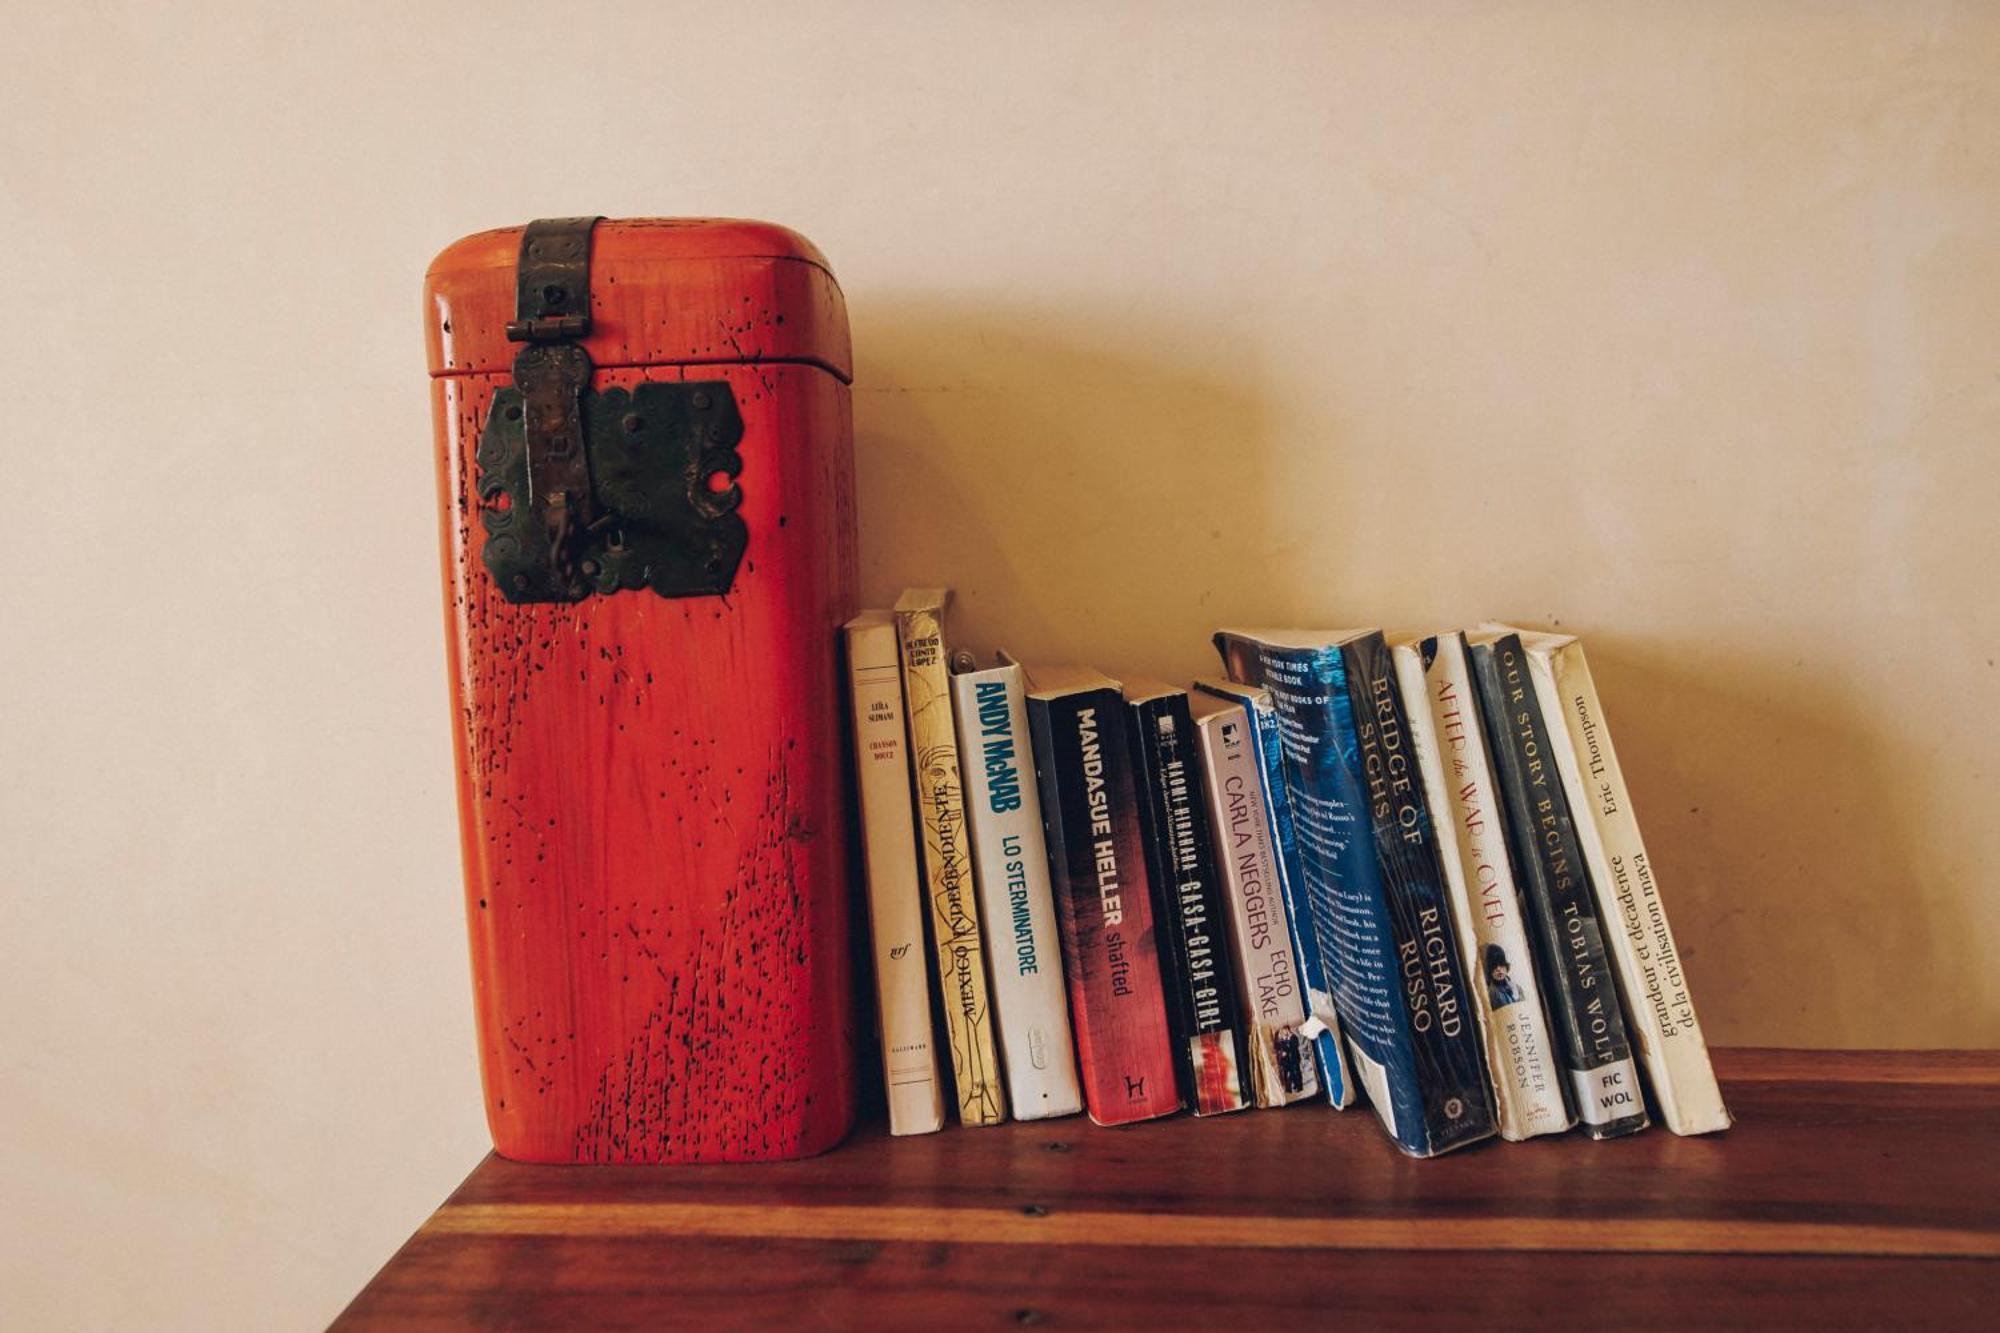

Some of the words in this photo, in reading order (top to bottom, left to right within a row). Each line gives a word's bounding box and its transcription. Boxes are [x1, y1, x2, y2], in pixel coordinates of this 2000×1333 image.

[975, 682, 1012, 737] ANDY
[1315, 696, 1329, 705] OF
[1360, 722, 1390, 819] SIGHS
[1372, 675, 1411, 796] BRIDGE
[1399, 804, 1423, 847] OF
[1503, 651, 1524, 704] OUR
[1517, 712, 1548, 788] STORY
[1538, 798, 1573, 891] BEGINS
[1575, 695, 1605, 780] Thompson
[983, 741, 1022, 814] McNAB
[1167, 760, 1188, 802] NAOMI
[1224, 776, 1253, 848] CARLA
[1438, 679, 1466, 752] AFTER
[1460, 782, 1485, 836] WAR
[1477, 864, 1505, 929] OVER
[1599, 782, 1617, 816] Eric
[1002, 835, 1021, 857] LO
[1077, 708, 1111, 837] MANDASUE
[1094, 839, 1122, 928] HELLER
[1173, 807, 1198, 872] HIRAHARA
[1006, 861, 1038, 976] STERMINATORE
[1180, 880, 1214, 982] GASA-GASA
[1238, 852, 1271, 950] NEGGERS
[1611, 855, 1645, 942] décadence
[890, 943, 911, 960] nrf
[1106, 931, 1132, 998] shafted
[1270, 949, 1293, 997] ECHO
[1419, 905, 1461, 1038] RICHARD
[1562, 901, 1596, 990] TOBIAS
[1636, 944, 1650, 960] et
[1647, 902, 1682, 987] civilisation
[1195, 987, 1221, 1029] GIRL
[1257, 974, 1280, 1019] LAKE
[1401, 938, 1432, 1033] RUSSO
[1645, 967, 1677, 1038] grandeur
[1671, 991, 1686, 1007] la
[1676, 1007, 1695, 1029] de
[1506, 1022, 1529, 1089] ROBSON
[1518, 1012, 1546, 1093] JENNIFER
[1602, 1072, 1622, 1088] FIC
[1600, 1091, 1633, 1109] WOL
